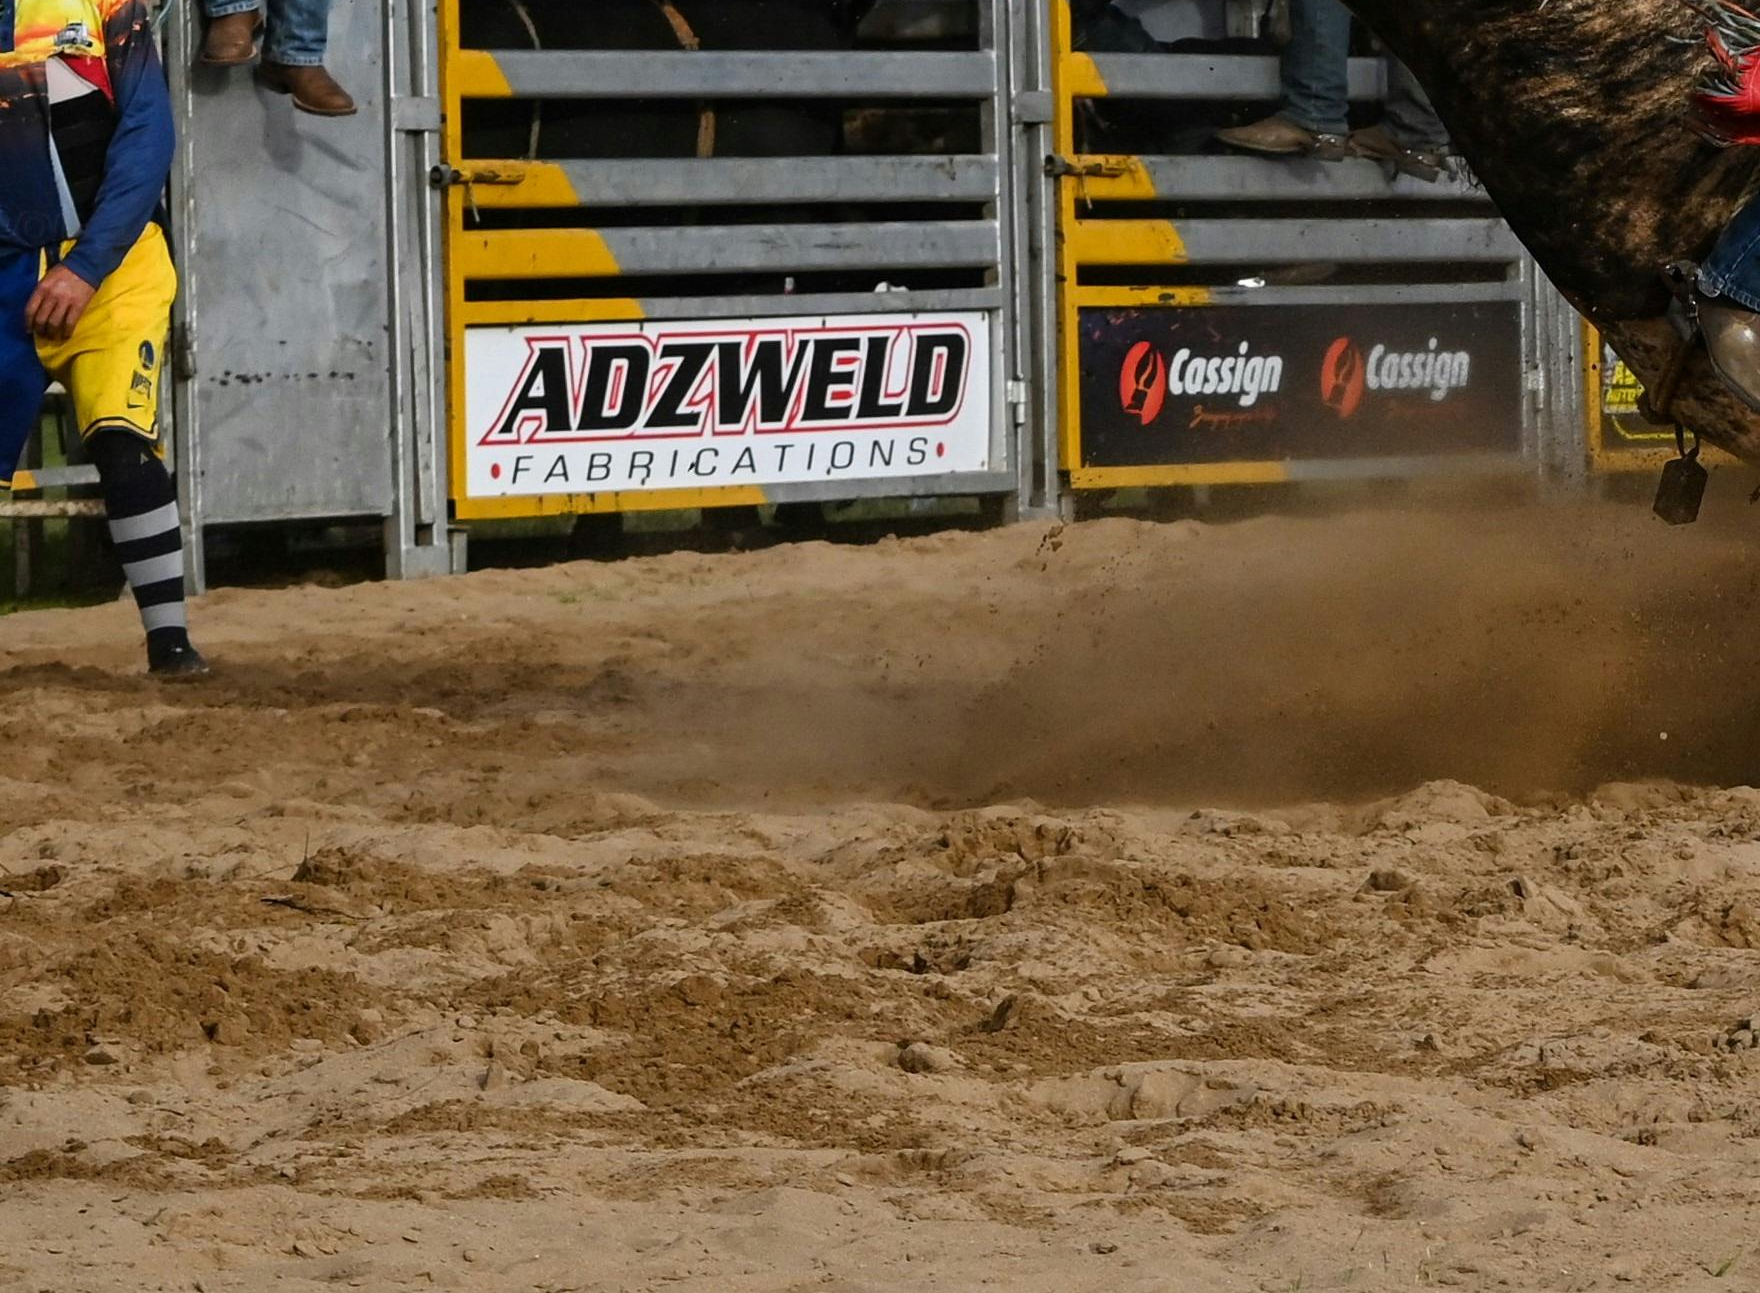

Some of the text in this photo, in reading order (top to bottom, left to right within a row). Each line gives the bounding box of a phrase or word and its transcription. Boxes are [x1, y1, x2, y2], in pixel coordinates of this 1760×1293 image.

[493, 330, 968, 436] ADZWELD
[1168, 340, 1284, 408] Cassign
[1366, 336, 1470, 402] Cassign
[511, 436, 929, 486] FABRICATIONS
